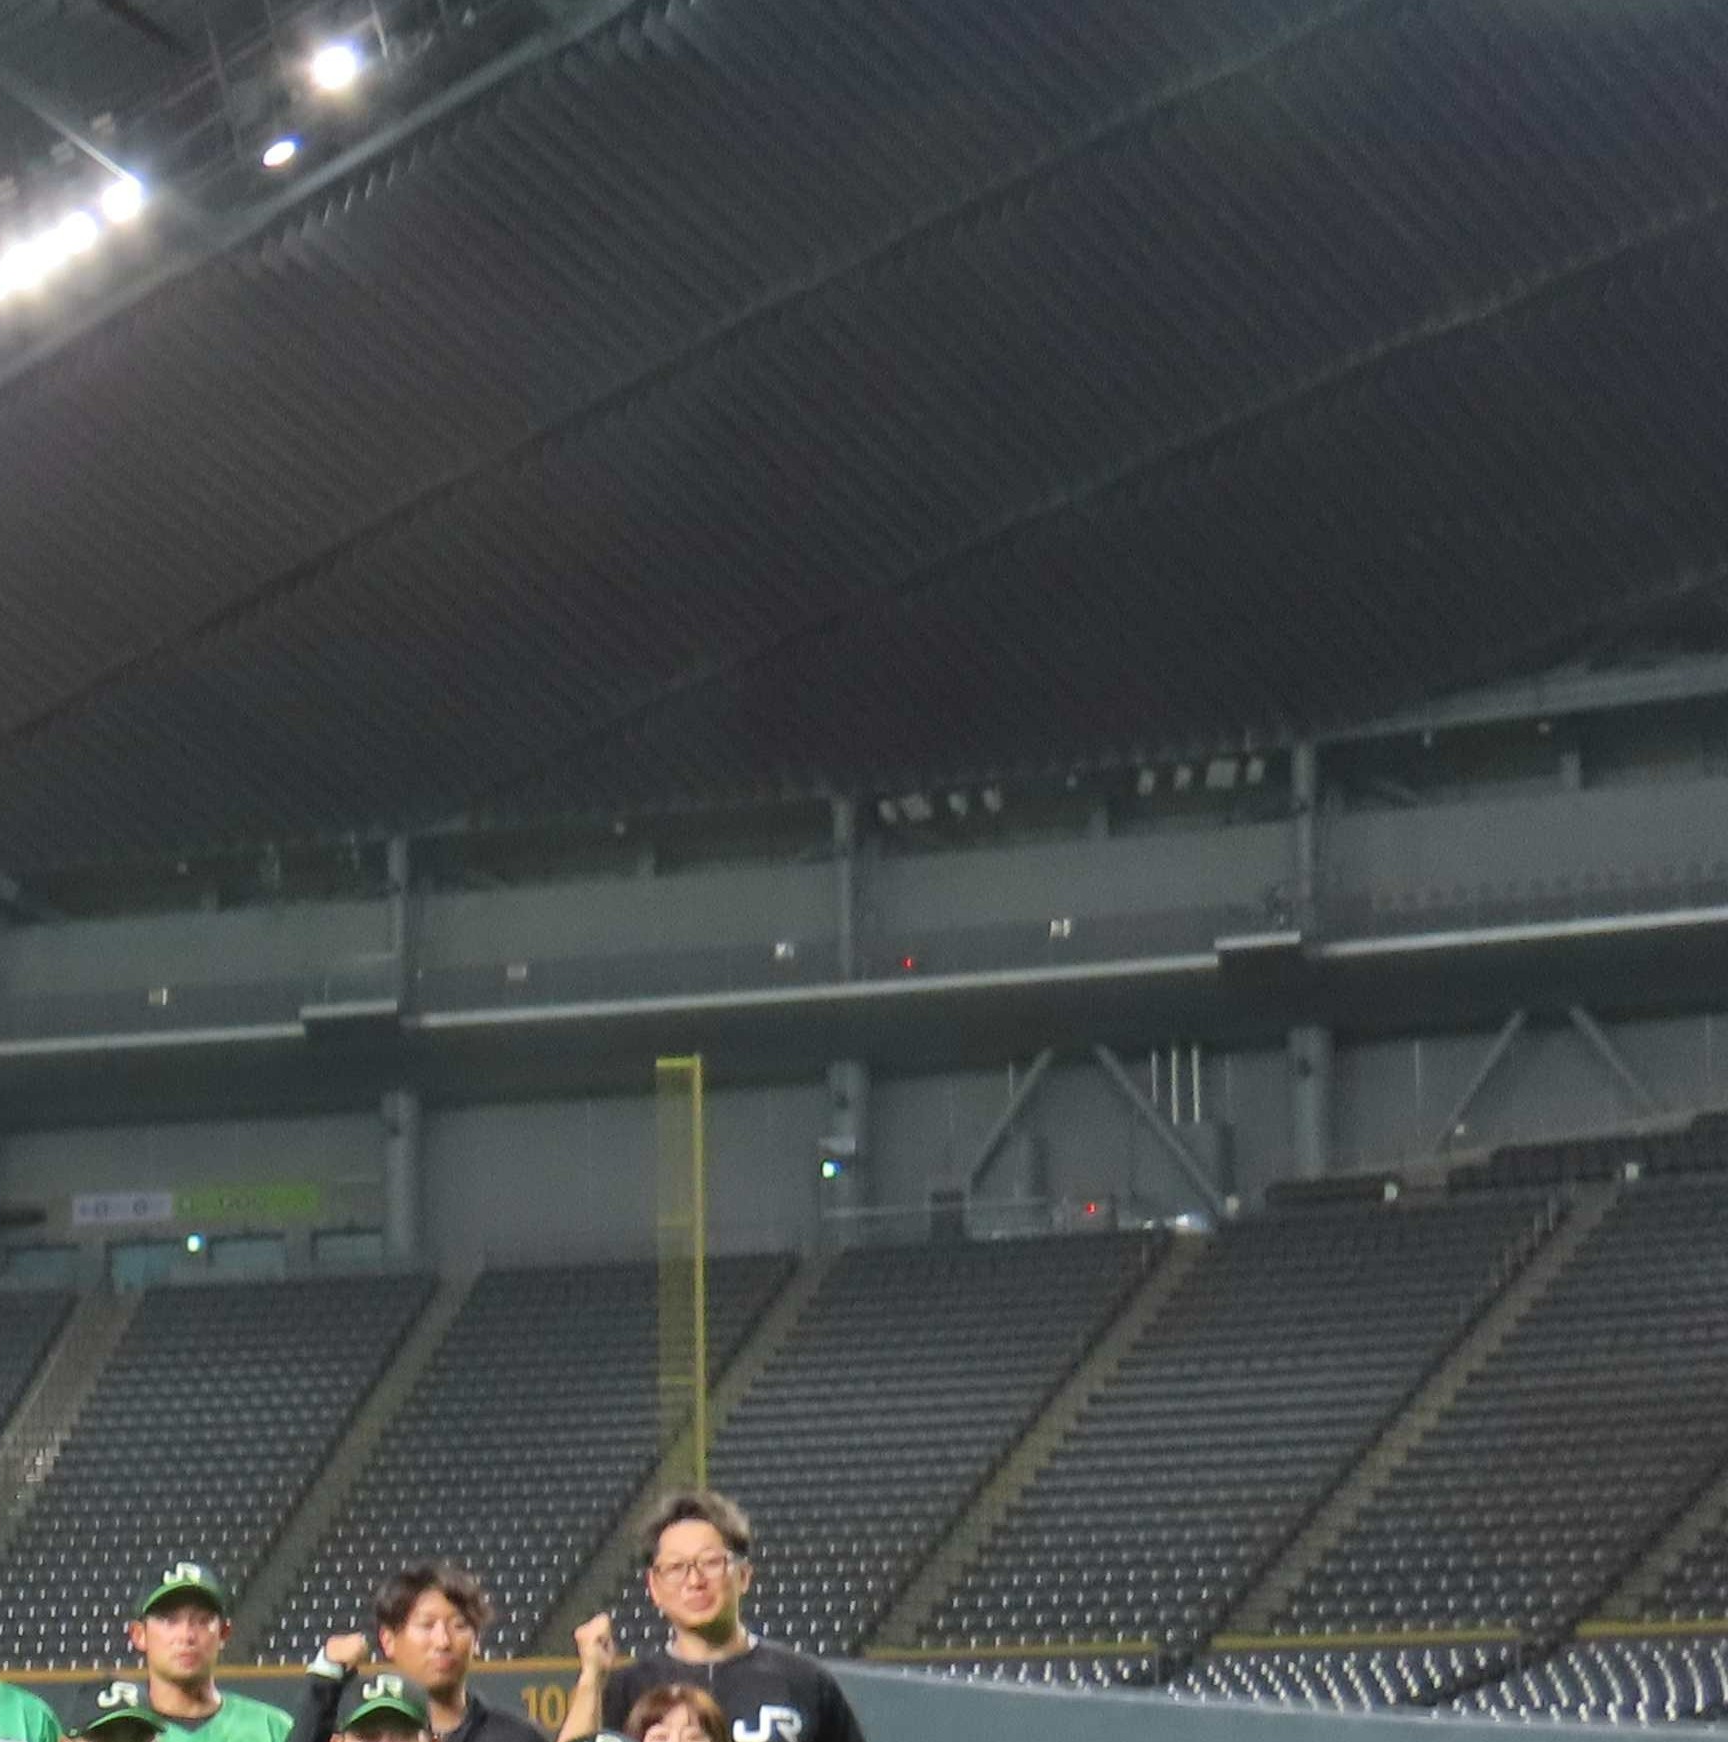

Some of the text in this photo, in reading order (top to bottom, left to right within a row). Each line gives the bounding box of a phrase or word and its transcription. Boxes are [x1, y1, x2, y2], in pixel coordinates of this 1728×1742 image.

[163, 1561, 201, 1586] JR
[98, 1682, 139, 1708] JR
[363, 1674, 403, 1698] JR
